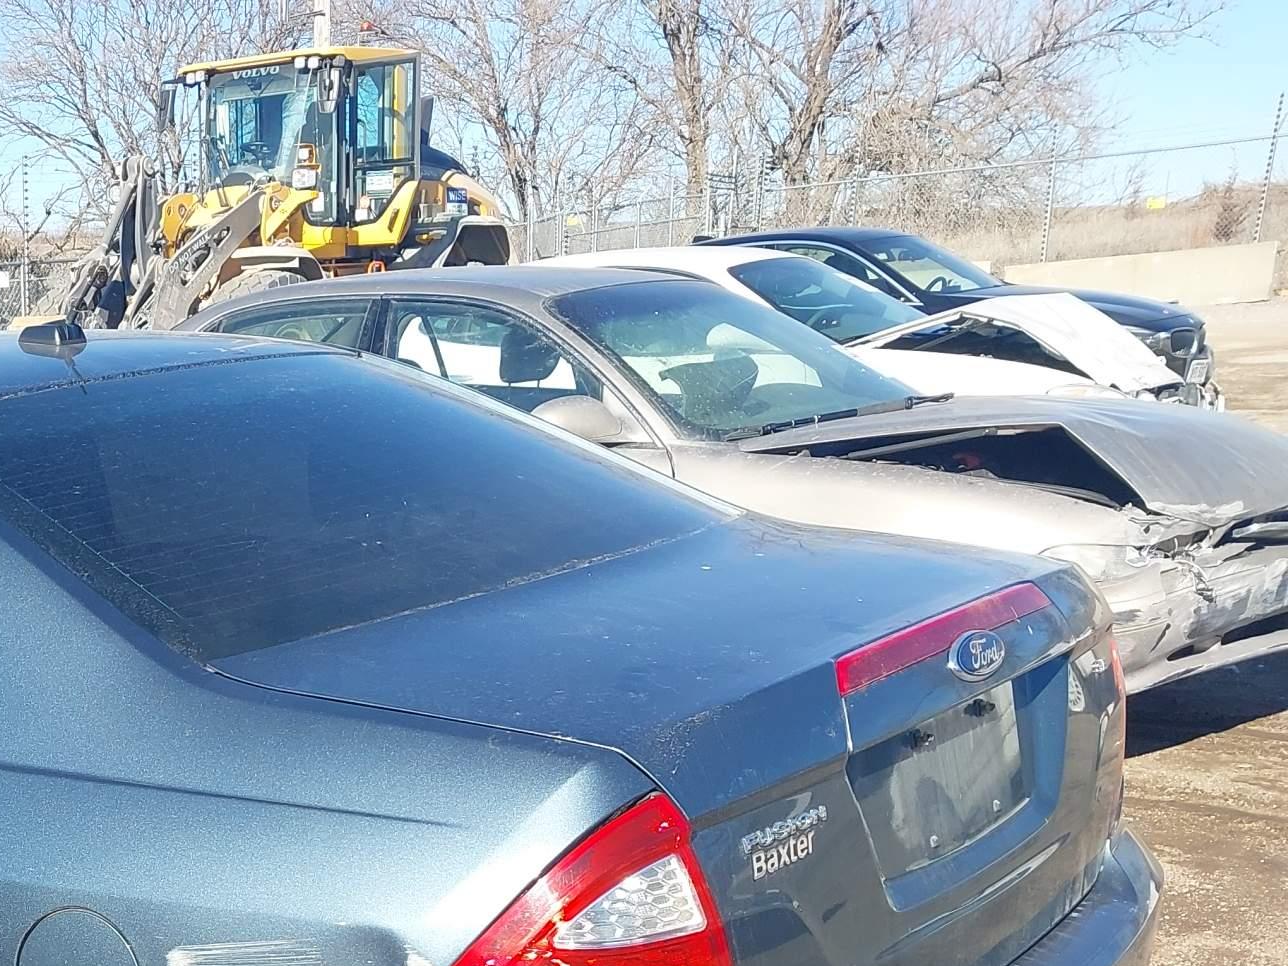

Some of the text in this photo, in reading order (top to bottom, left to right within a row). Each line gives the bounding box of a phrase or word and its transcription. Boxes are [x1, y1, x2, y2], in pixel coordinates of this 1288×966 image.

[232, 65, 280, 80] VOLVO
[448, 190, 467, 201] WISE
[179, 248, 193, 264] NOT
[969, 637, 1000, 669] Ford
[742, 804, 827, 855] FUSION
[752, 830, 815, 881] Baxter
